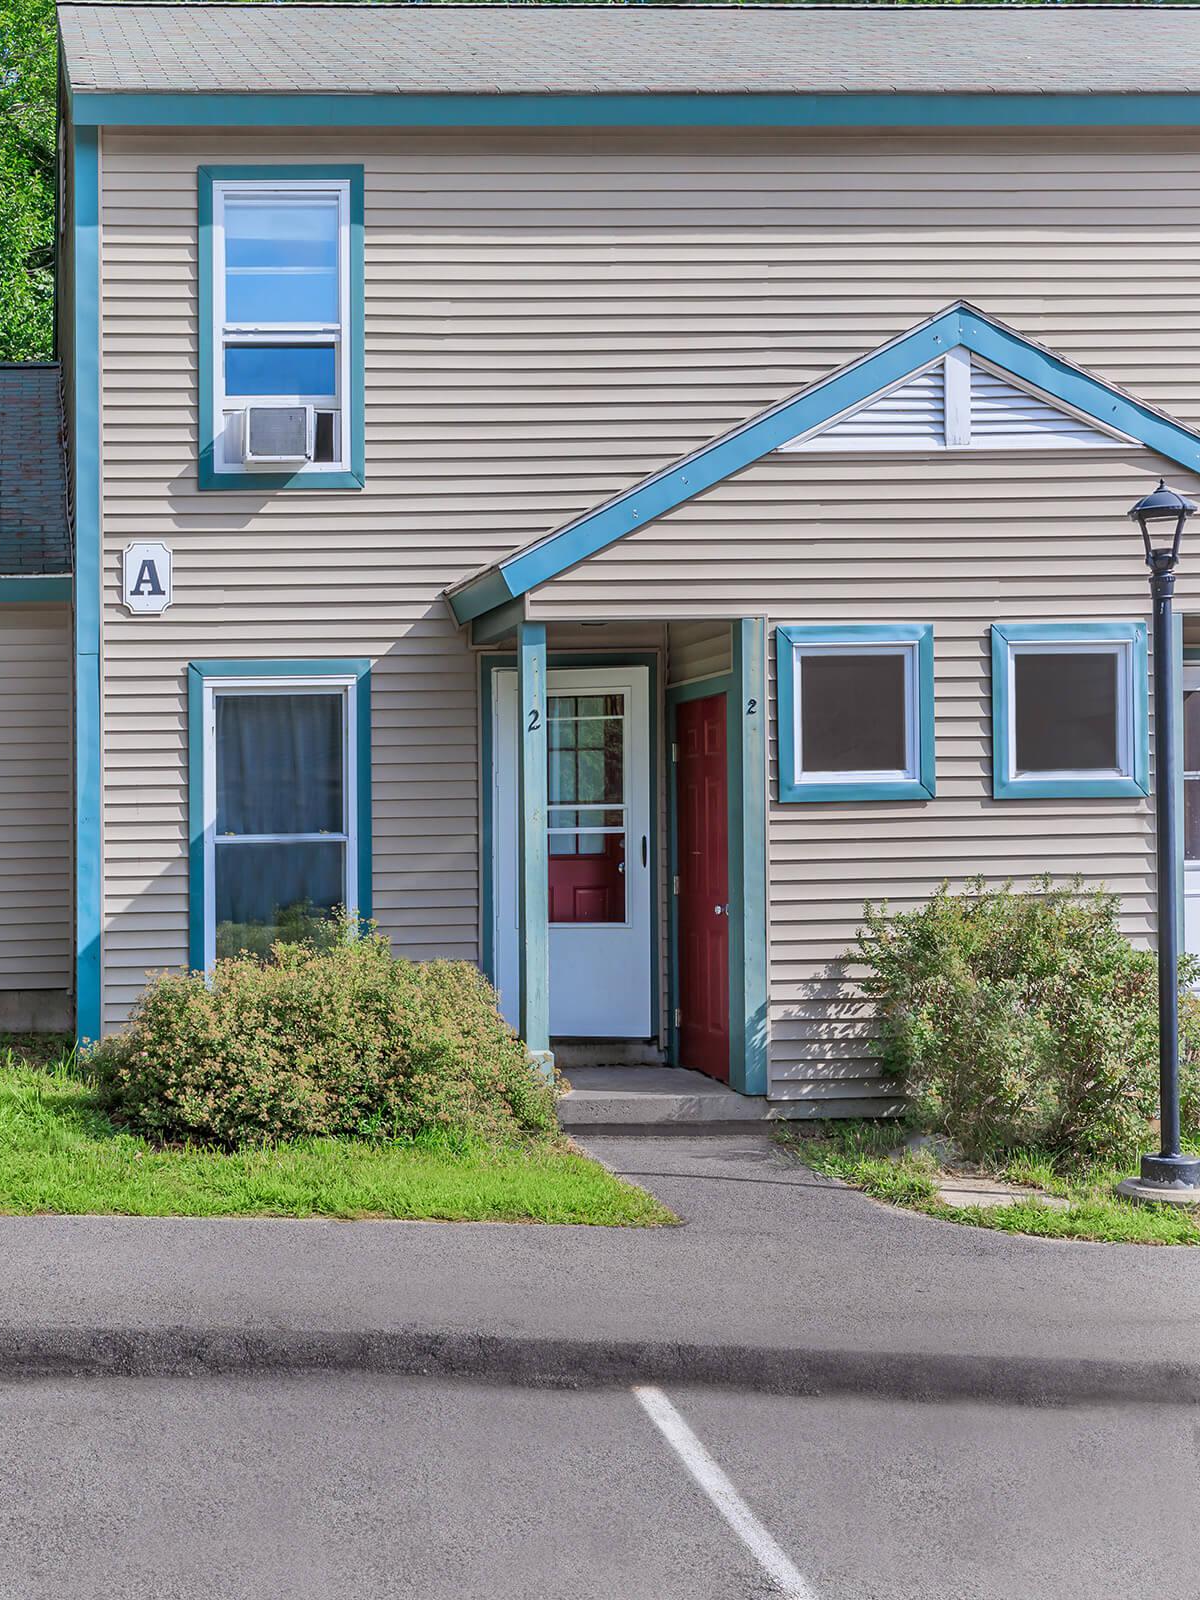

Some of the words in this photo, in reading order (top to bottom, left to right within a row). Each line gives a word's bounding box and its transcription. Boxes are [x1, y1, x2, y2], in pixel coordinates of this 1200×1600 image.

[130, 559, 166, 596] A
[746, 698, 757, 716] 2
[527, 709, 541, 733] 2
